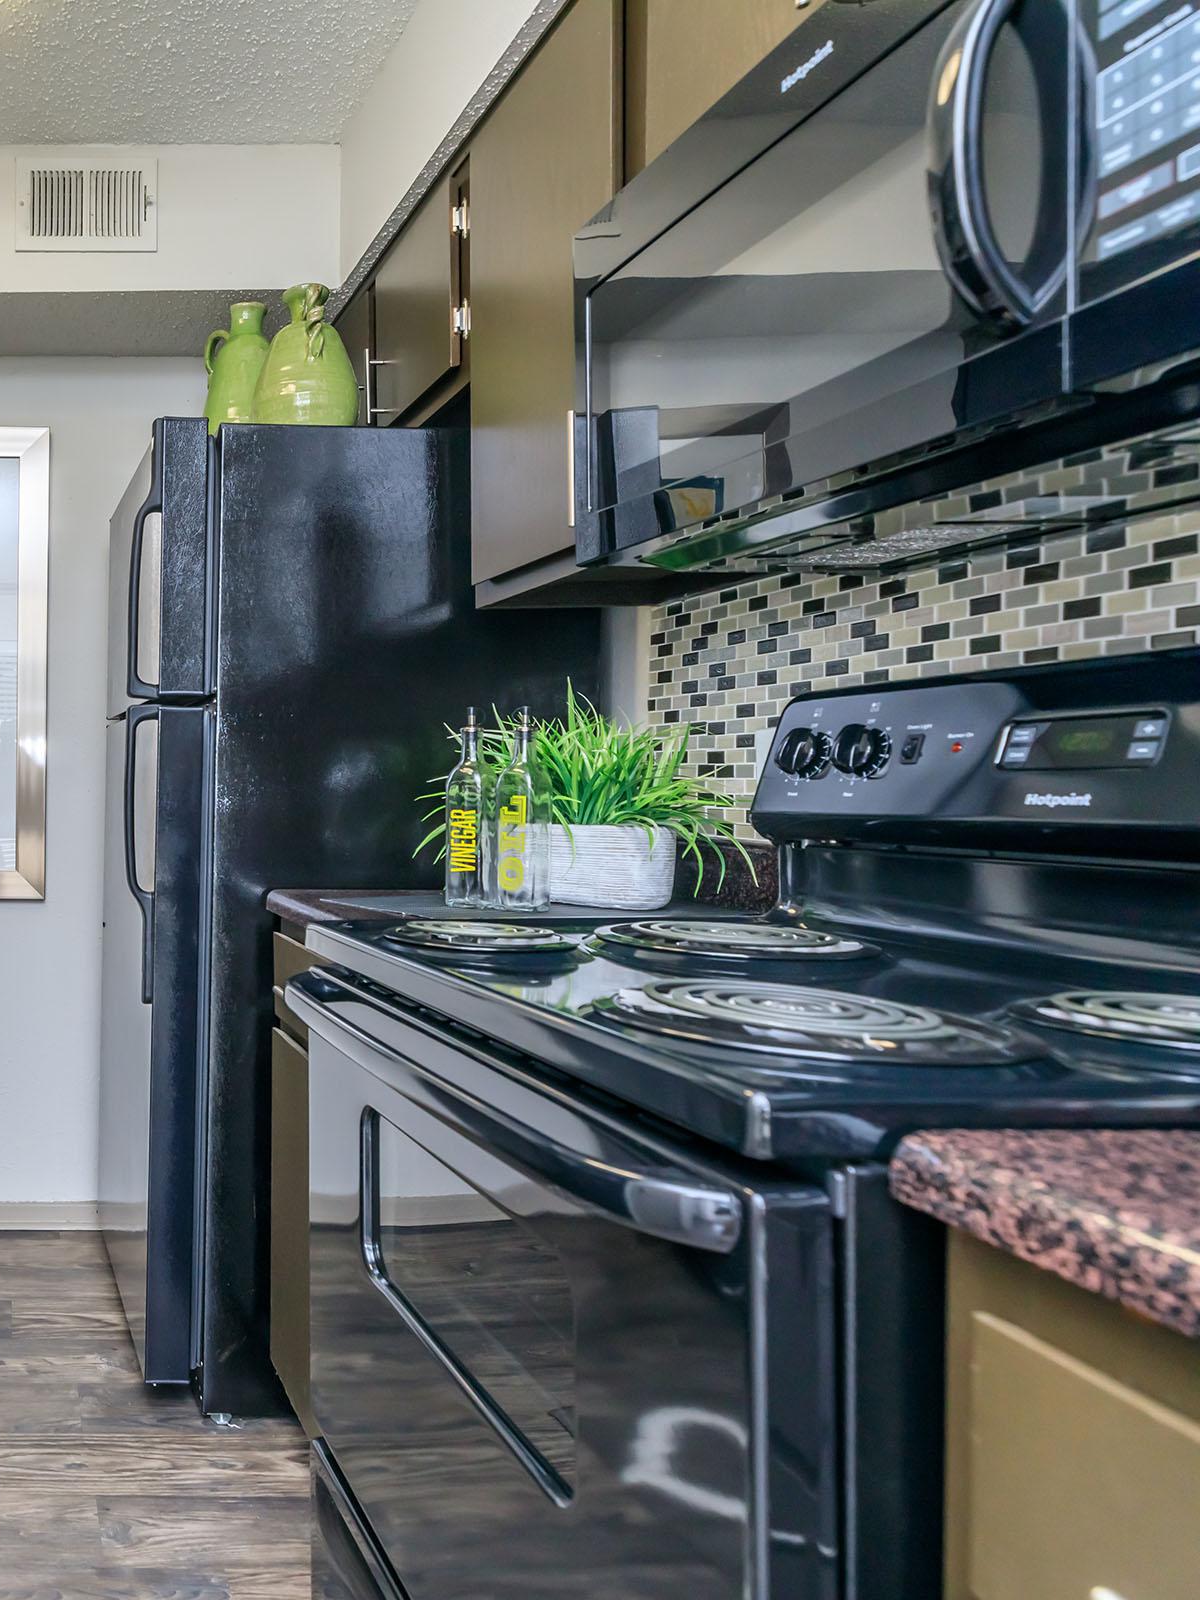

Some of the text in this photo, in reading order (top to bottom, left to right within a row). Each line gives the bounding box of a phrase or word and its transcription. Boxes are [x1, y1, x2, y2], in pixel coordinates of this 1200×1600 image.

[781, 39, 834, 93] Hotpoint
[1024, 792, 1092, 808] Hotpoint
[449, 809, 477, 873] VINEGAR
[498, 795, 527, 893] OIL
